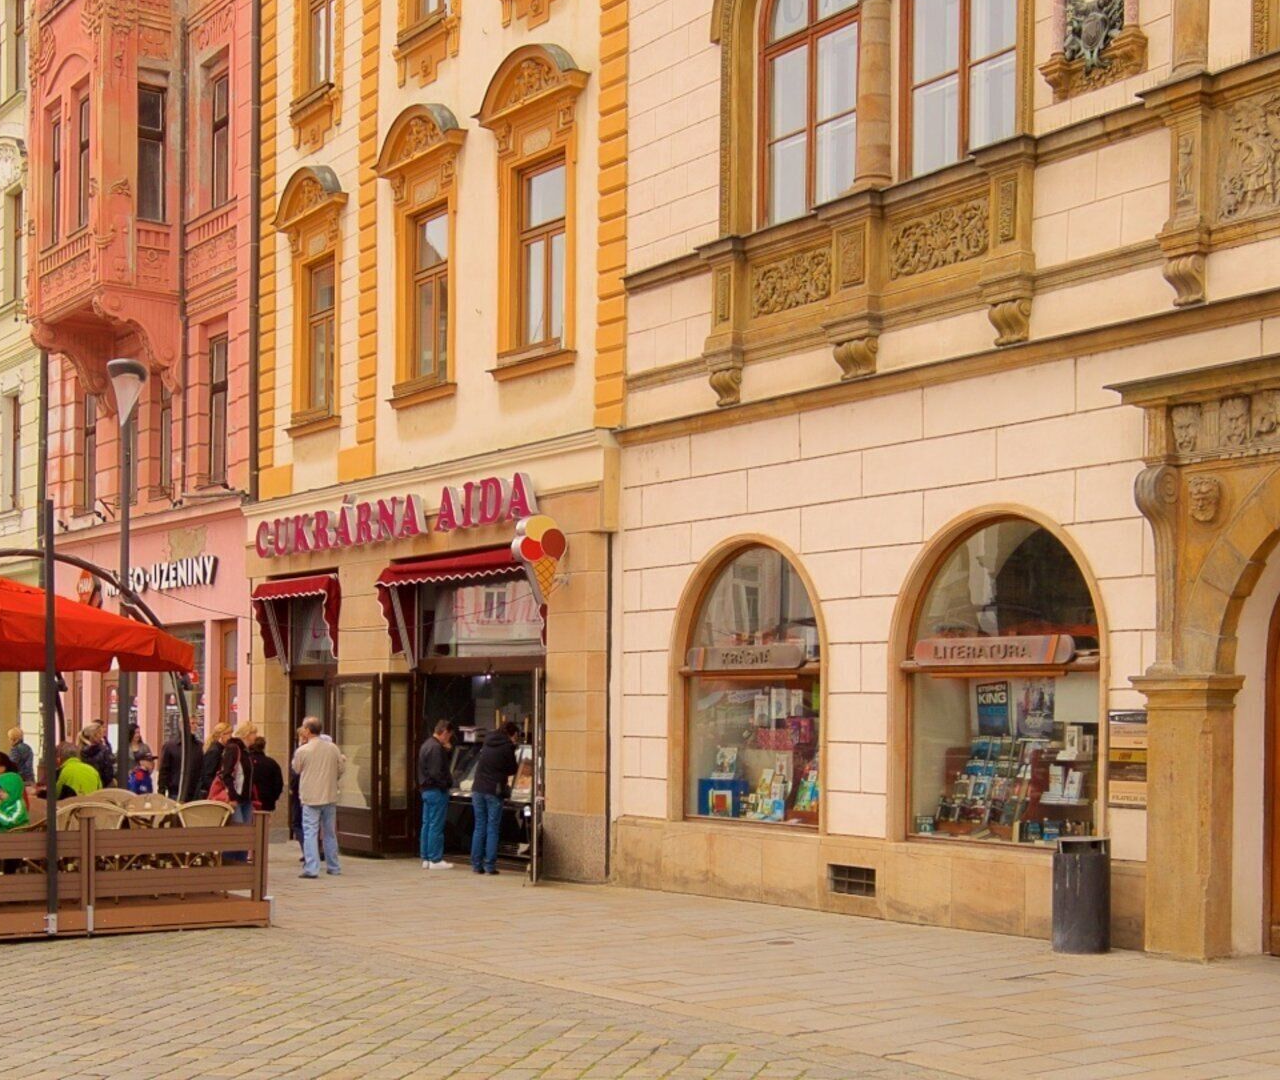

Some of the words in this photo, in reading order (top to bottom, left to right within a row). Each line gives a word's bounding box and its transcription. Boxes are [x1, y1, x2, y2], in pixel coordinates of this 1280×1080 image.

[255, 494, 425, 558] CUKRÁRNA
[434, 472, 536, 532] AIDA
[933, 645, 1032, 661] LITERATURA
[978, 692, 1007, 705] KING
